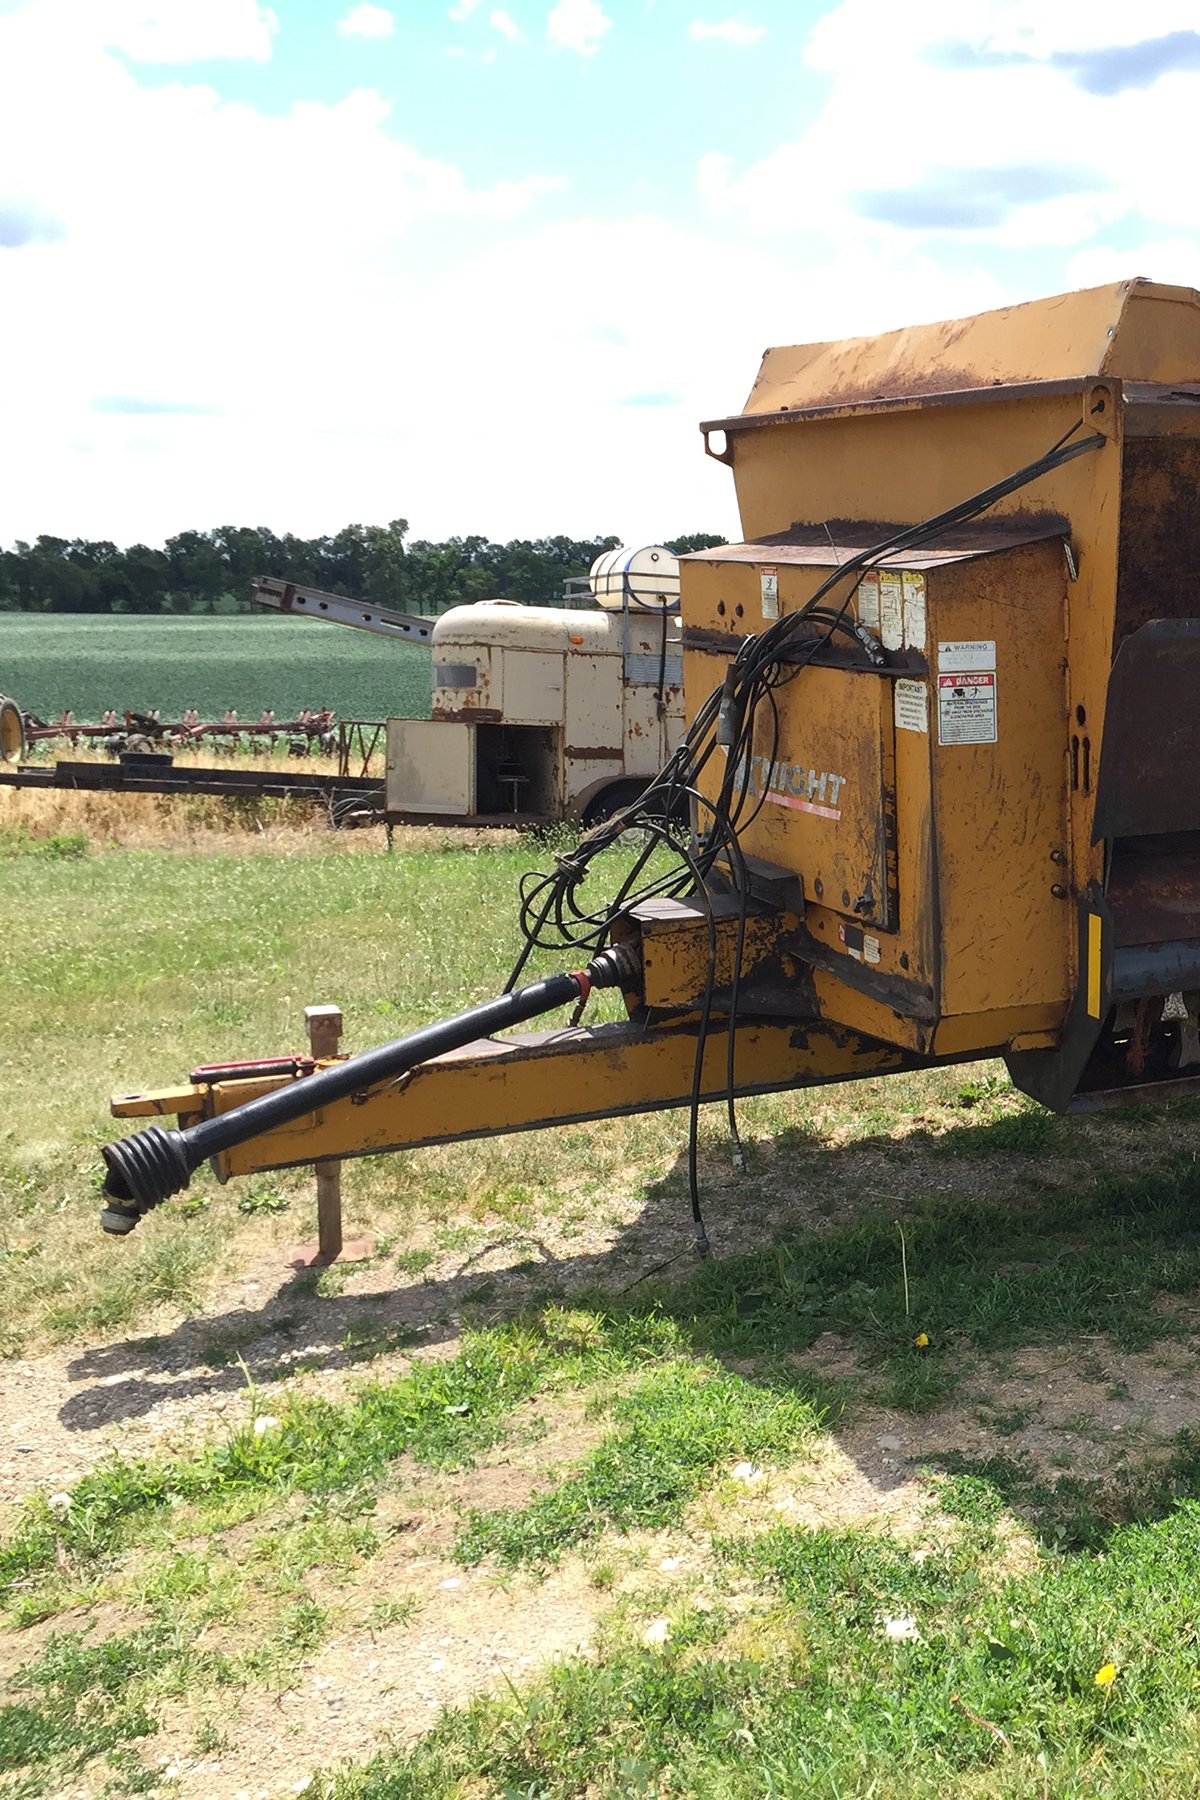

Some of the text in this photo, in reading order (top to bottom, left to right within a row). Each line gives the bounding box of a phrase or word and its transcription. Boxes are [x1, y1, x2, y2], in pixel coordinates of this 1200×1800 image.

[954, 643, 988, 651] WARNING
[956, 676, 989, 686] DANGER
[734, 756, 846, 804] KNIGHT
